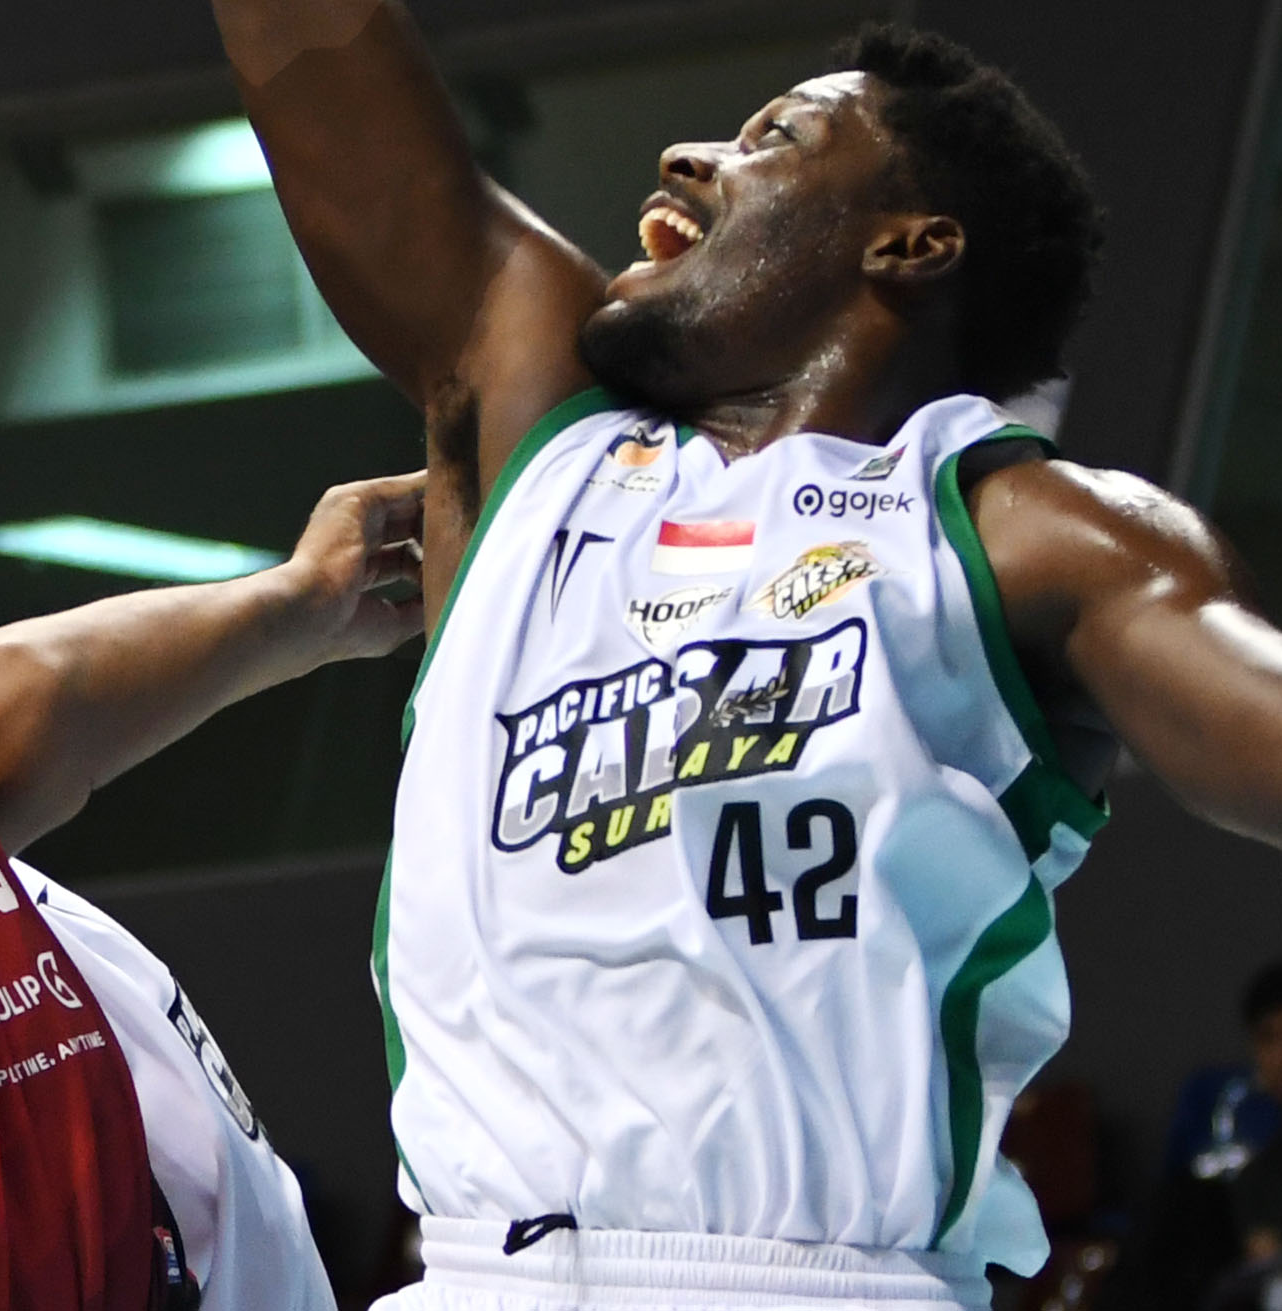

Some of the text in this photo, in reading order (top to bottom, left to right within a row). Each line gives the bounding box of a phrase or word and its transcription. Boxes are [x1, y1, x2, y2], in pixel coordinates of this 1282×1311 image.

[829, 490, 915, 520] gojek
[515, 663, 662, 755] PACIFIC
[706, 798, 858, 945] 42
